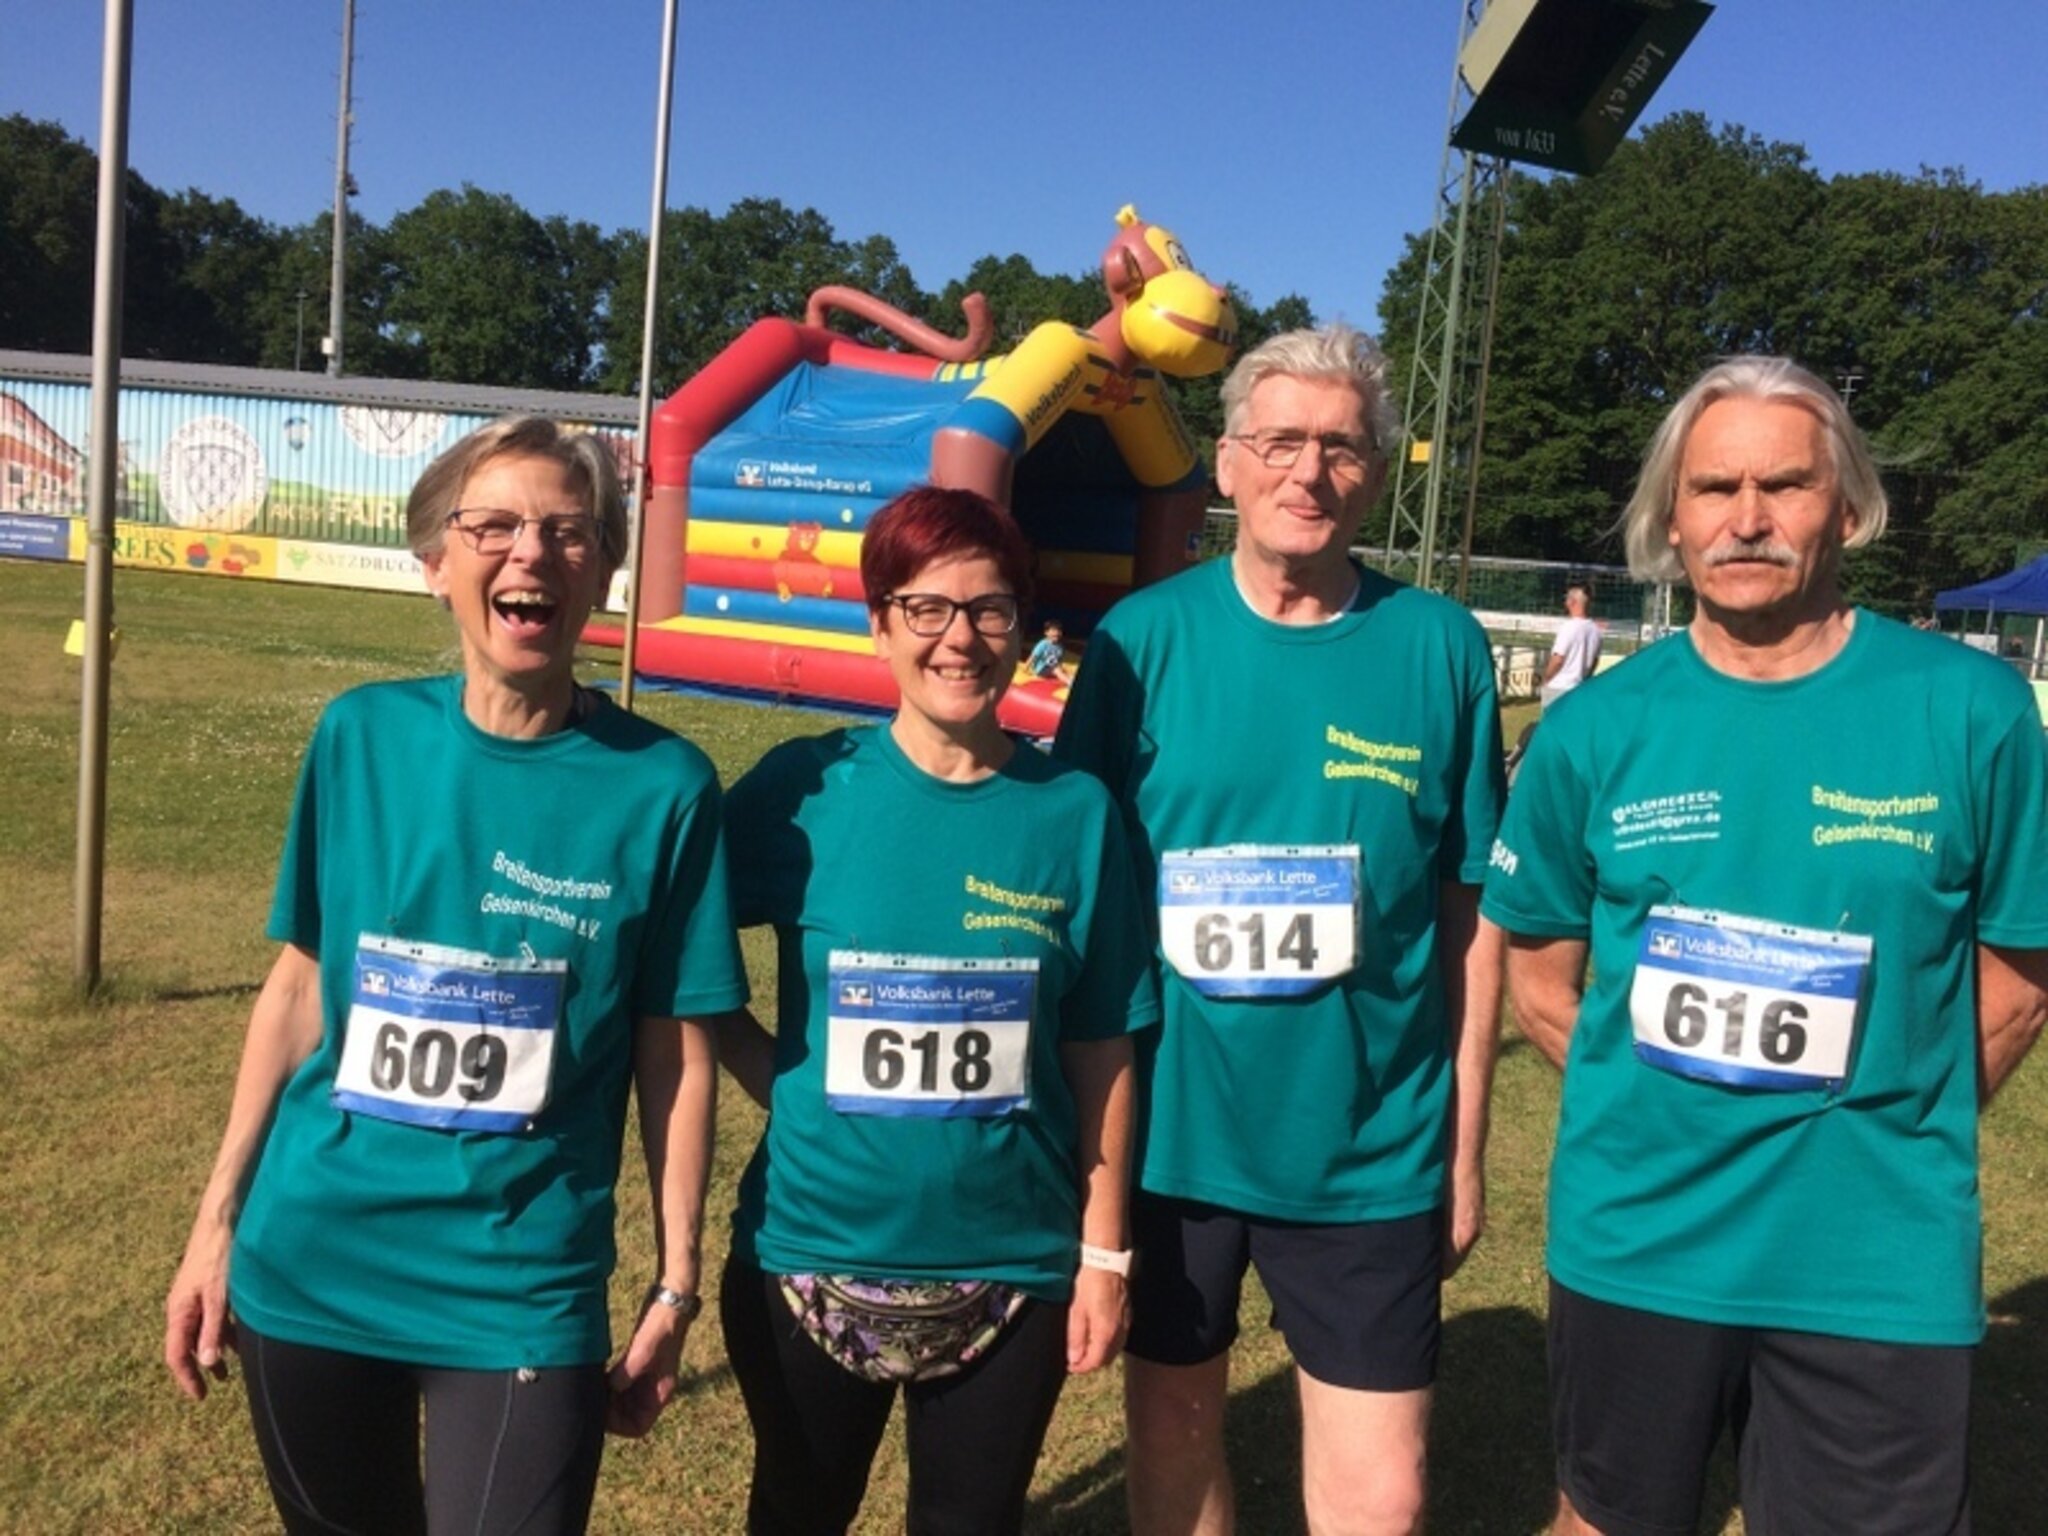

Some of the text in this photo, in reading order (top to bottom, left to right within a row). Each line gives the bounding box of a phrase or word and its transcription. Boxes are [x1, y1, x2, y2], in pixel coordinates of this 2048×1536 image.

[1812, 822, 1914, 847] Gelsenkirchen
[491, 849, 613, 900] Breitensportverein
[1204, 869, 1317, 885] Volksbank Lette
[480, 891, 577, 931] Gelsenkirchen
[1193, 912, 1319, 973] 614
[1684, 936, 1770, 964] Volksbank
[392, 974, 467, 999] Volksbank
[471, 985, 516, 1005] Lette
[876, 984, 996, 1002] Volksbank Lette
[1663, 981, 1809, 1066] 616
[370, 1021, 508, 1103] 609
[862, 1028, 992, 1092] 618
